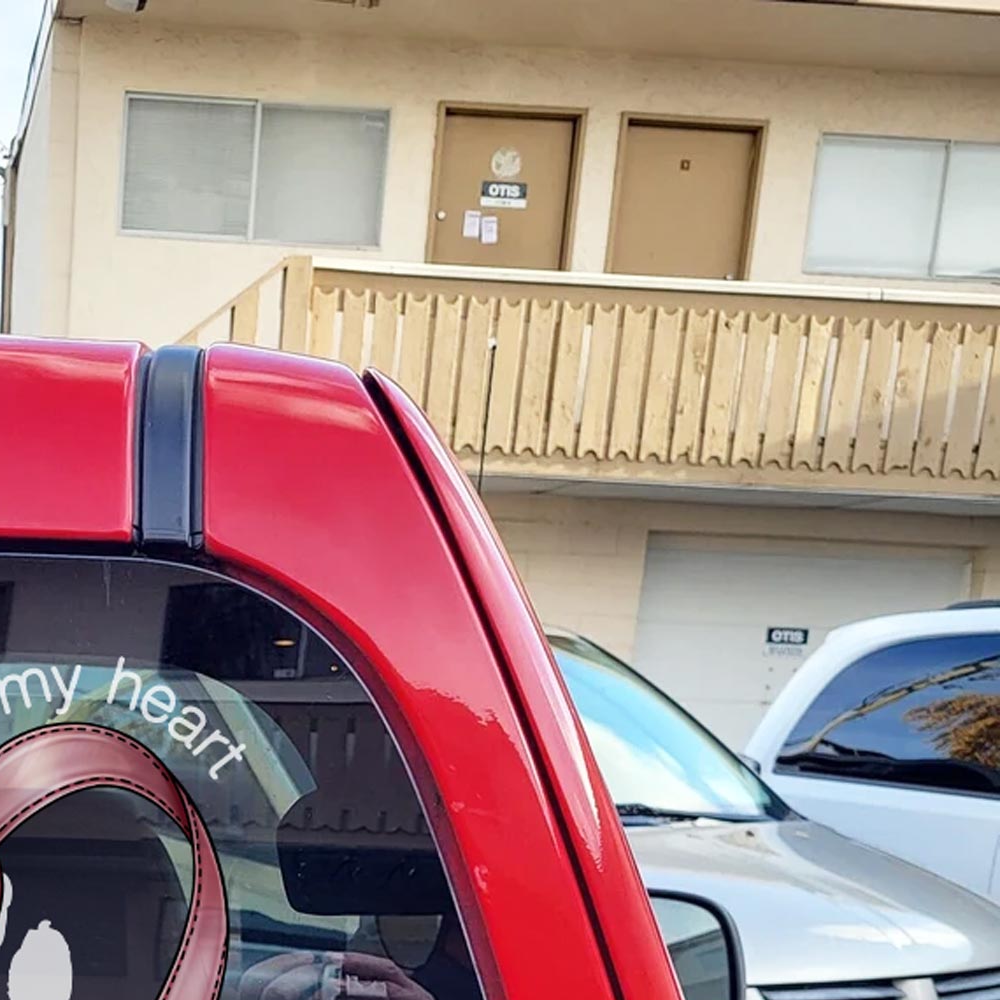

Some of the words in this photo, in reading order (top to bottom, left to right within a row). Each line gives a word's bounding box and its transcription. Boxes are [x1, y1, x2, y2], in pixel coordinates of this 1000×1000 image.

[488, 183, 520, 198] OTIS
[771, 629, 804, 643] OTIS
[107, 656, 246, 780] heart
